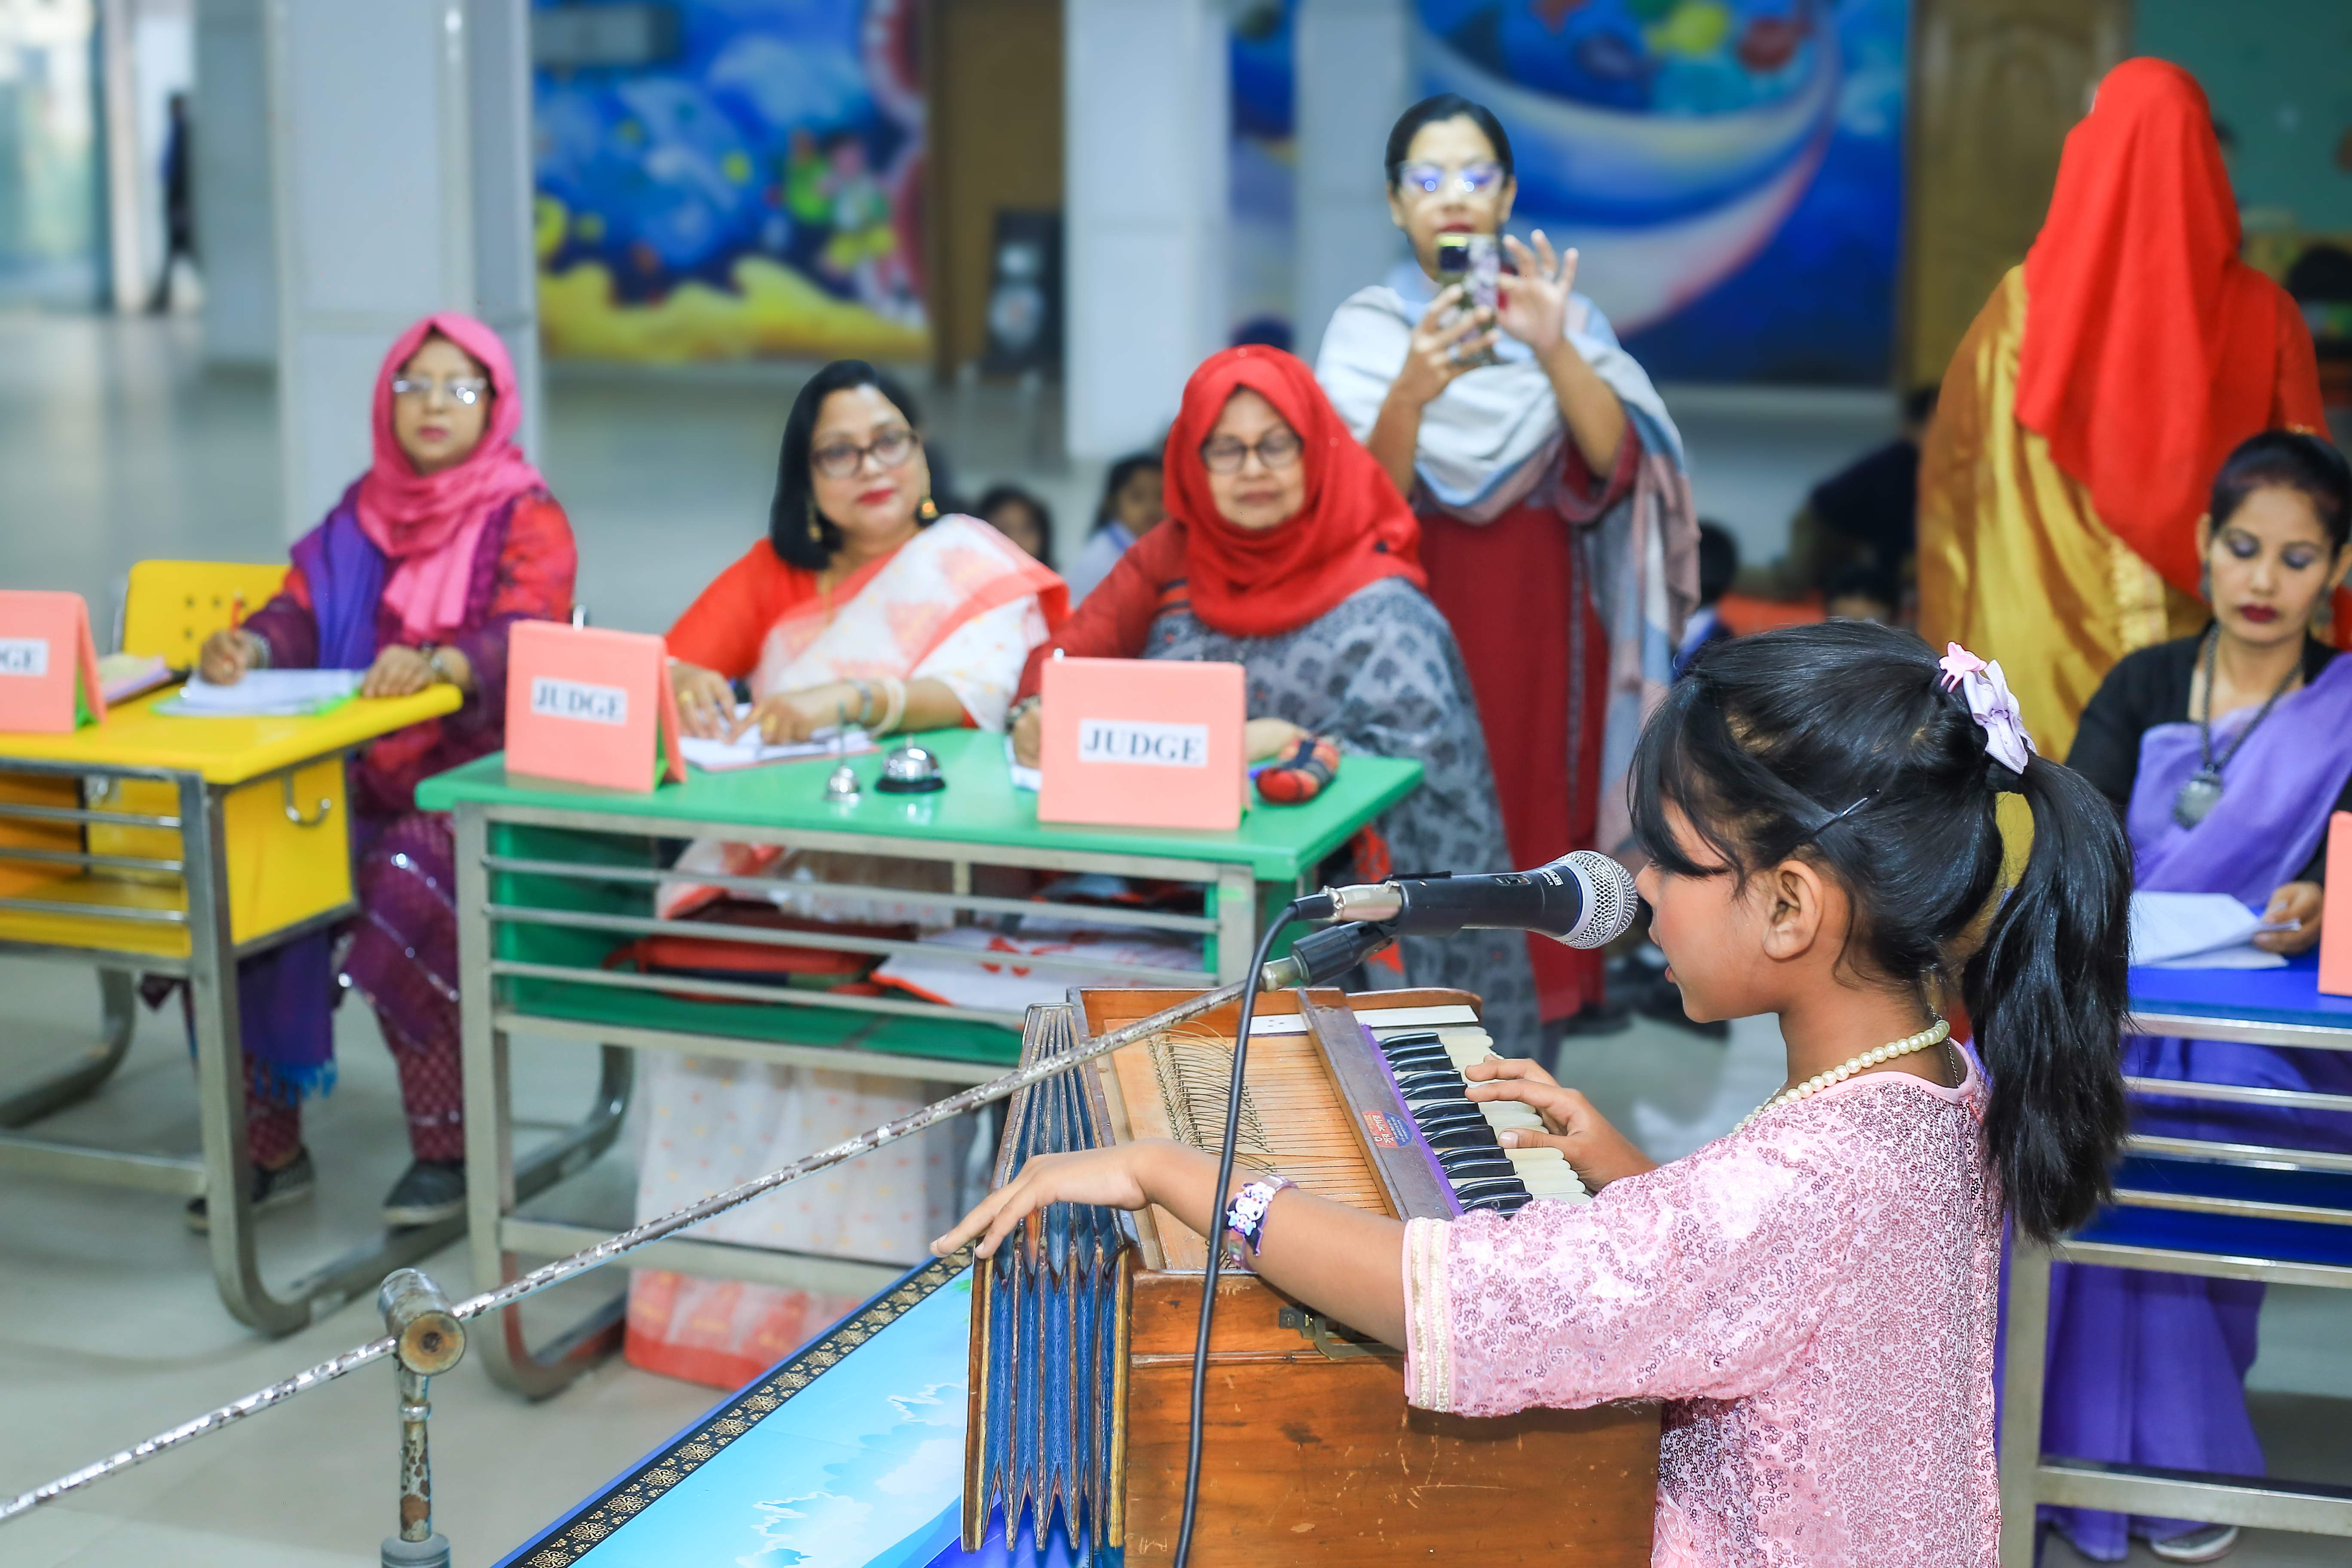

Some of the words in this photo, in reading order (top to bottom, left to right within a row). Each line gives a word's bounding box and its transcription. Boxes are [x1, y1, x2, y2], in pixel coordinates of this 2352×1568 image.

[536, 686, 622, 719] JUDGE
[1084, 729, 1203, 763] JUDGE
[1372, 1115, 1386, 1132] সাগর
[1381, 1133, 1394, 1143] সুর
